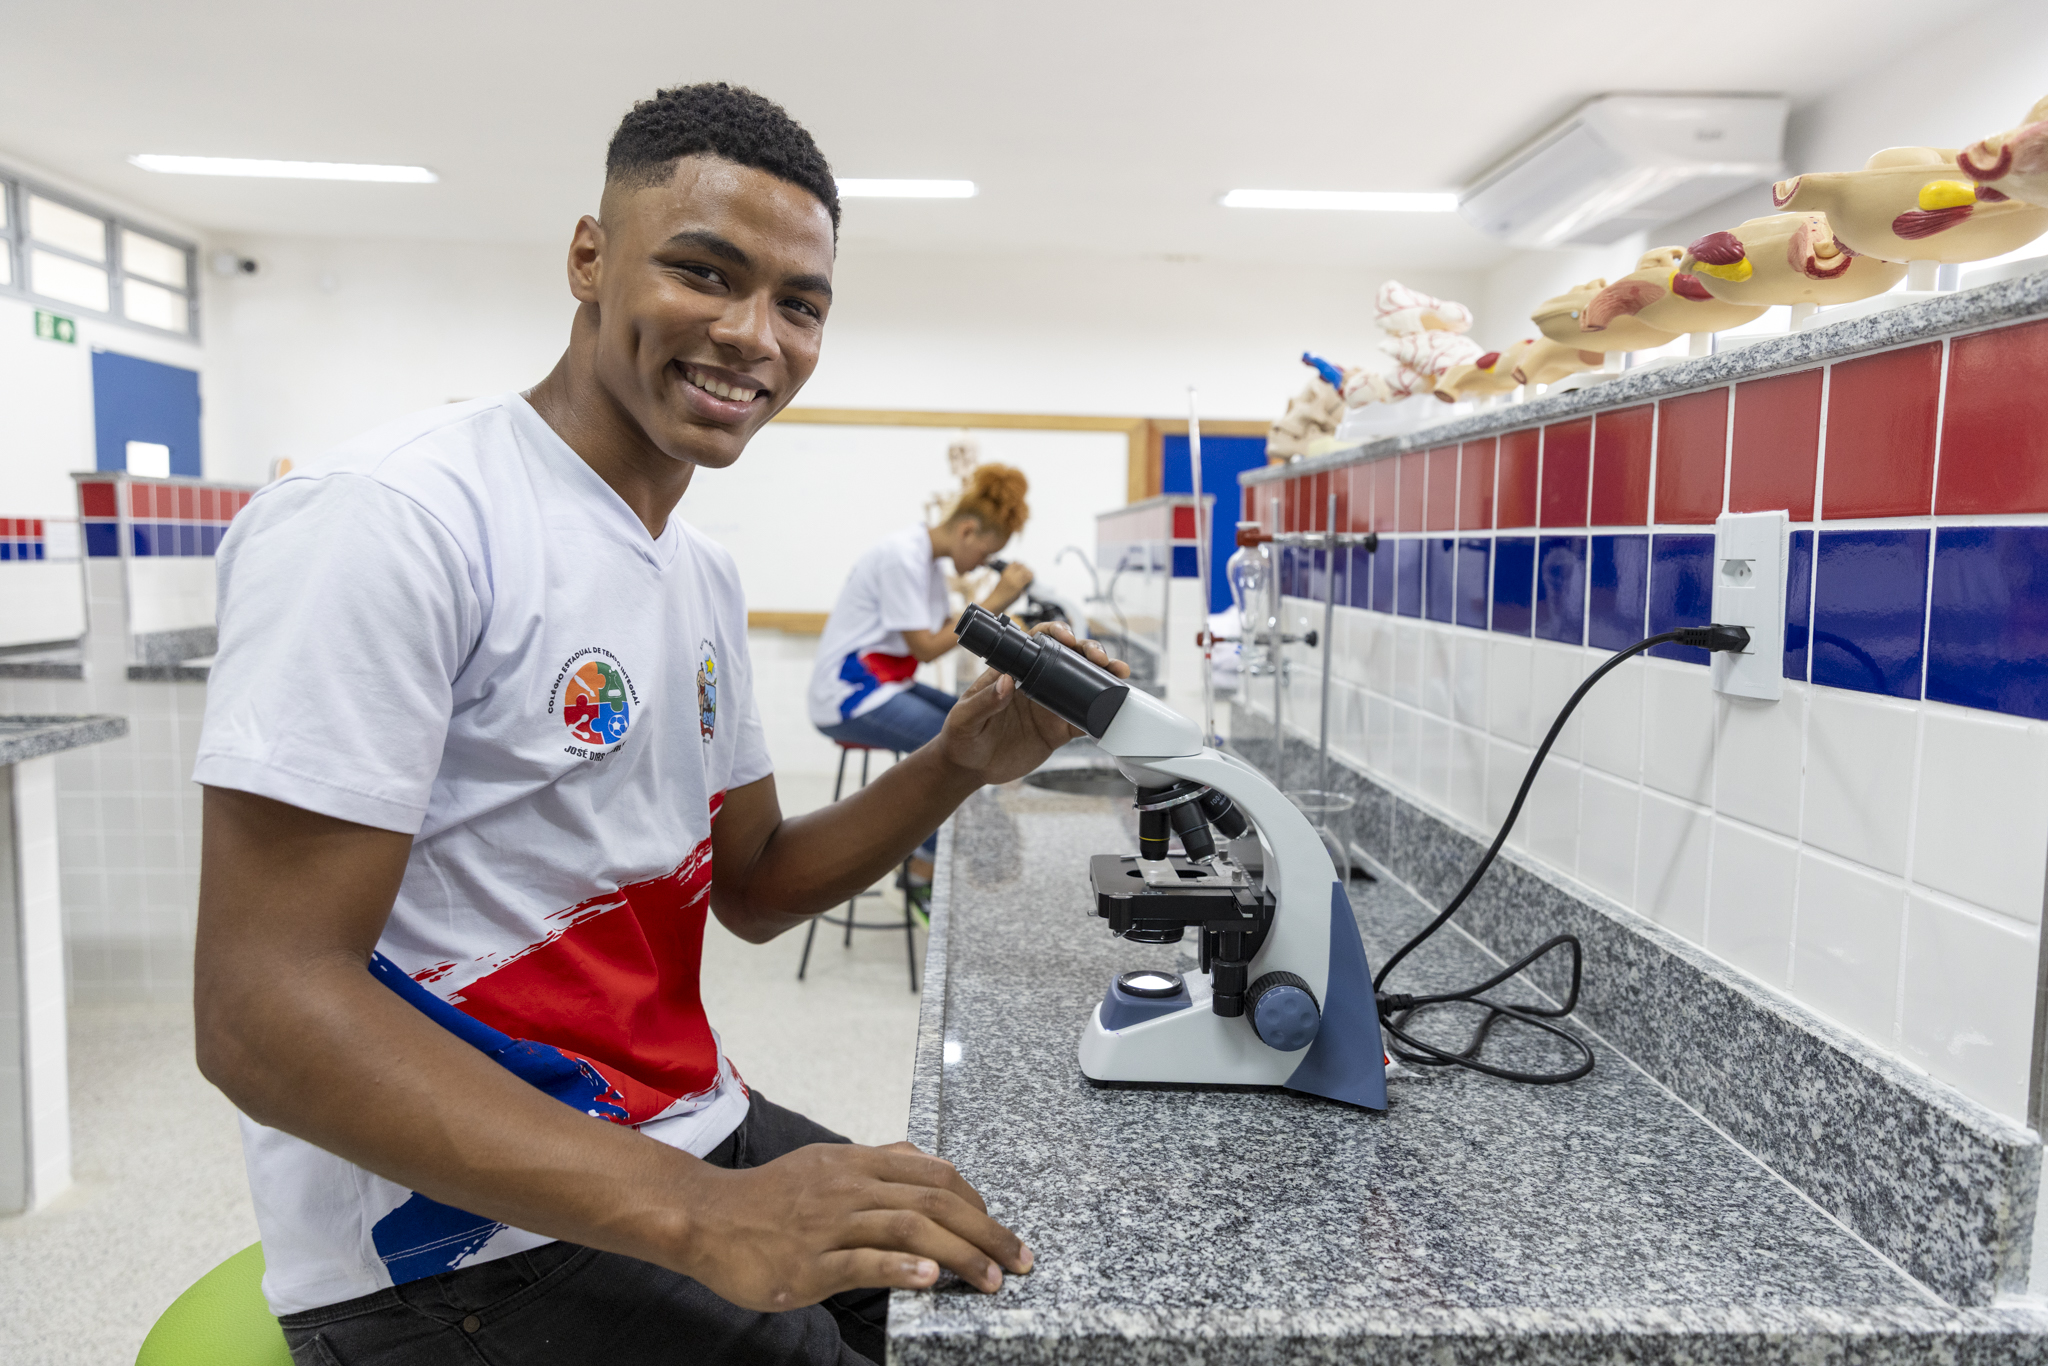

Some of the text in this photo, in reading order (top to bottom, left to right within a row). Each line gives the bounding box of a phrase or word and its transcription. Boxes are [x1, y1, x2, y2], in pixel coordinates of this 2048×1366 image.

[548, 673, 564, 714] COLÉGIO
[561, 647, 592, 673] ESTADUAL
[592, 646, 601, 654] DE
[620, 666, 640, 706] INTEGRAL
[564, 745, 588, 759] JOSÉ
